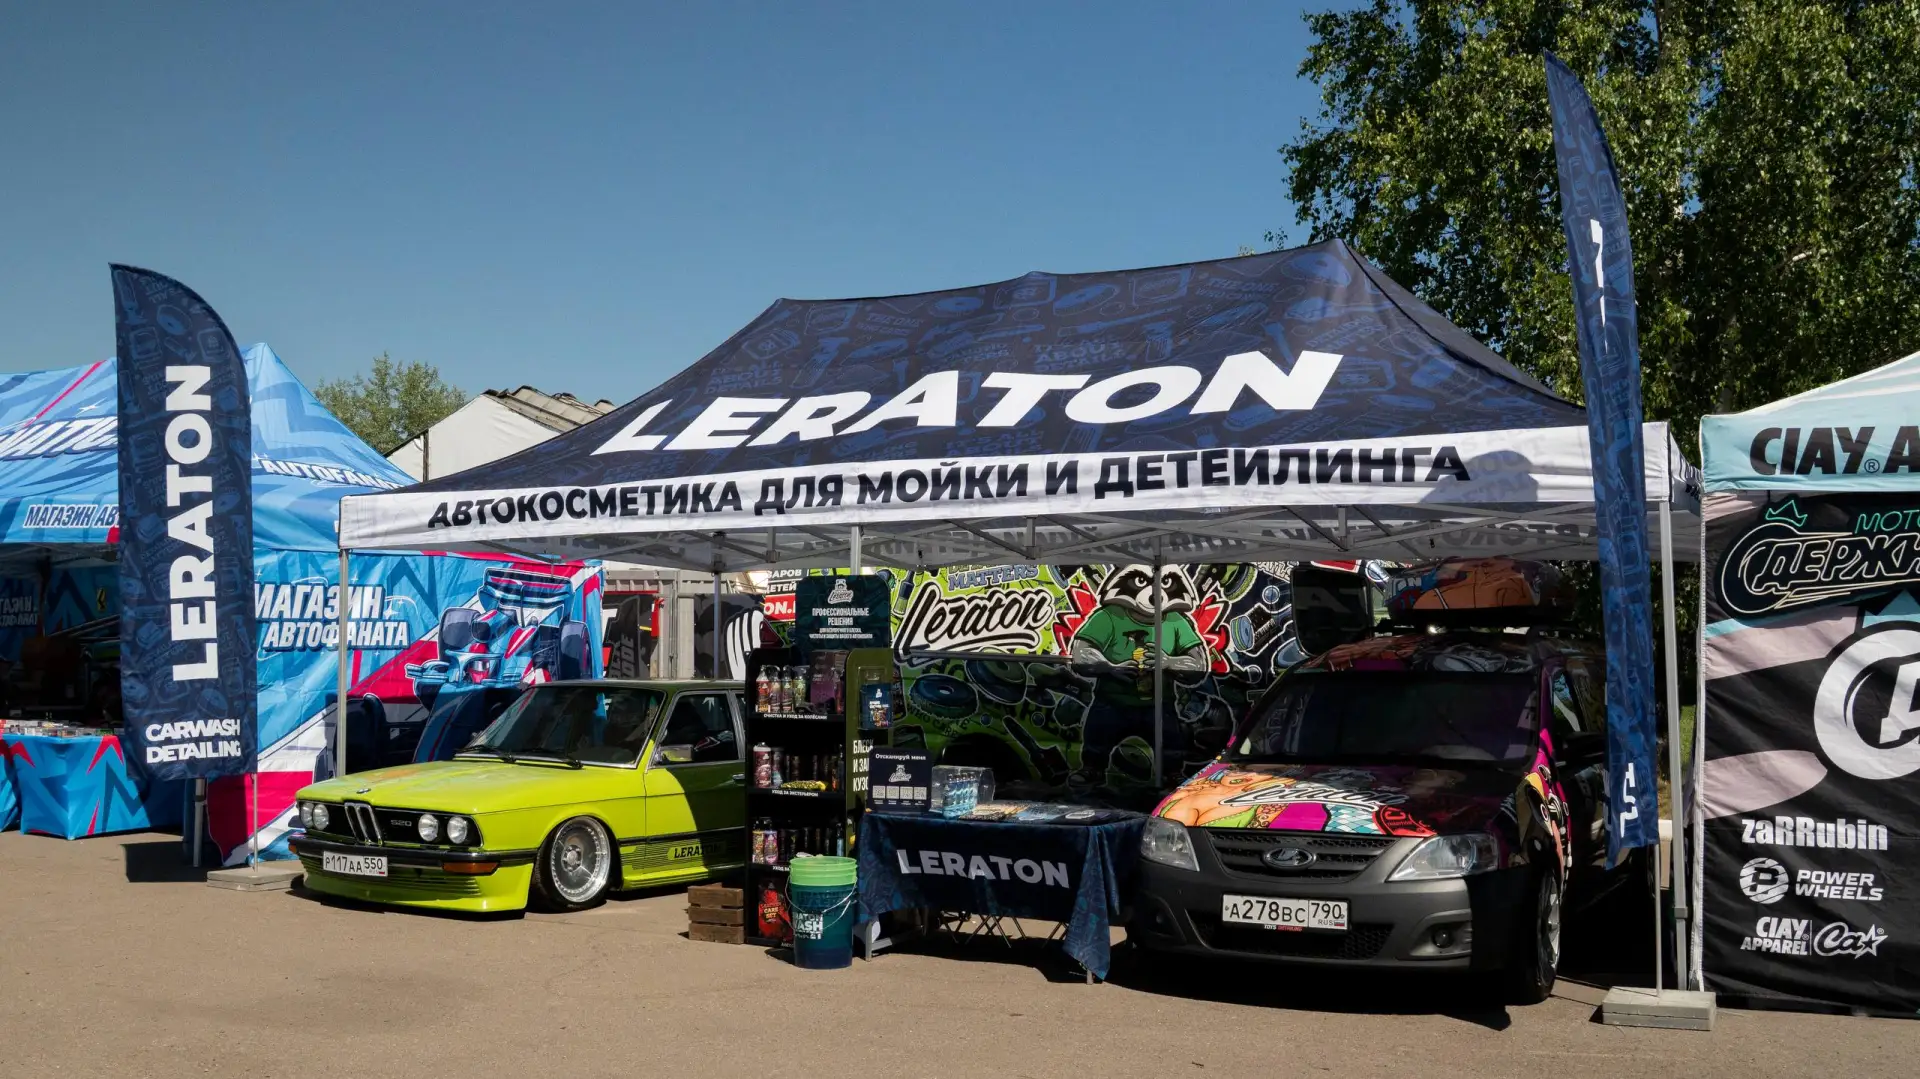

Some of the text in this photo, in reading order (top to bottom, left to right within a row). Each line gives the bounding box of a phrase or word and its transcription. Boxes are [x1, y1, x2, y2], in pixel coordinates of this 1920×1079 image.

[590, 350, 1344, 456] LERATON
[428, 481, 743, 528] АВТОКОСМЕТИКА
[754, 474, 843, 516] ДЛЯ
[857, 461, 1028, 505] МОЙКИ
[1045, 460, 1079, 495] И
[24, 505, 96, 527] МАГАЗИН
[164, 365, 219, 681] LERATON
[948, 564, 1039, 591] MATTERS
[896, 581, 1053, 659] Leraton
[263, 621, 409, 650] АВТОФАНАТА
[146, 719, 241, 741] CARWASH
[146, 740, 241, 764] DETAILING
[1741, 816, 1888, 850] zaRRubin
[896, 849, 1070, 889] LERATON
[1797, 869, 1875, 887] POWER
[1795, 884, 1884, 901] WHEELS
[1311, 903, 1342, 919] 790
[1740, 936, 1808, 956] APPAREL
